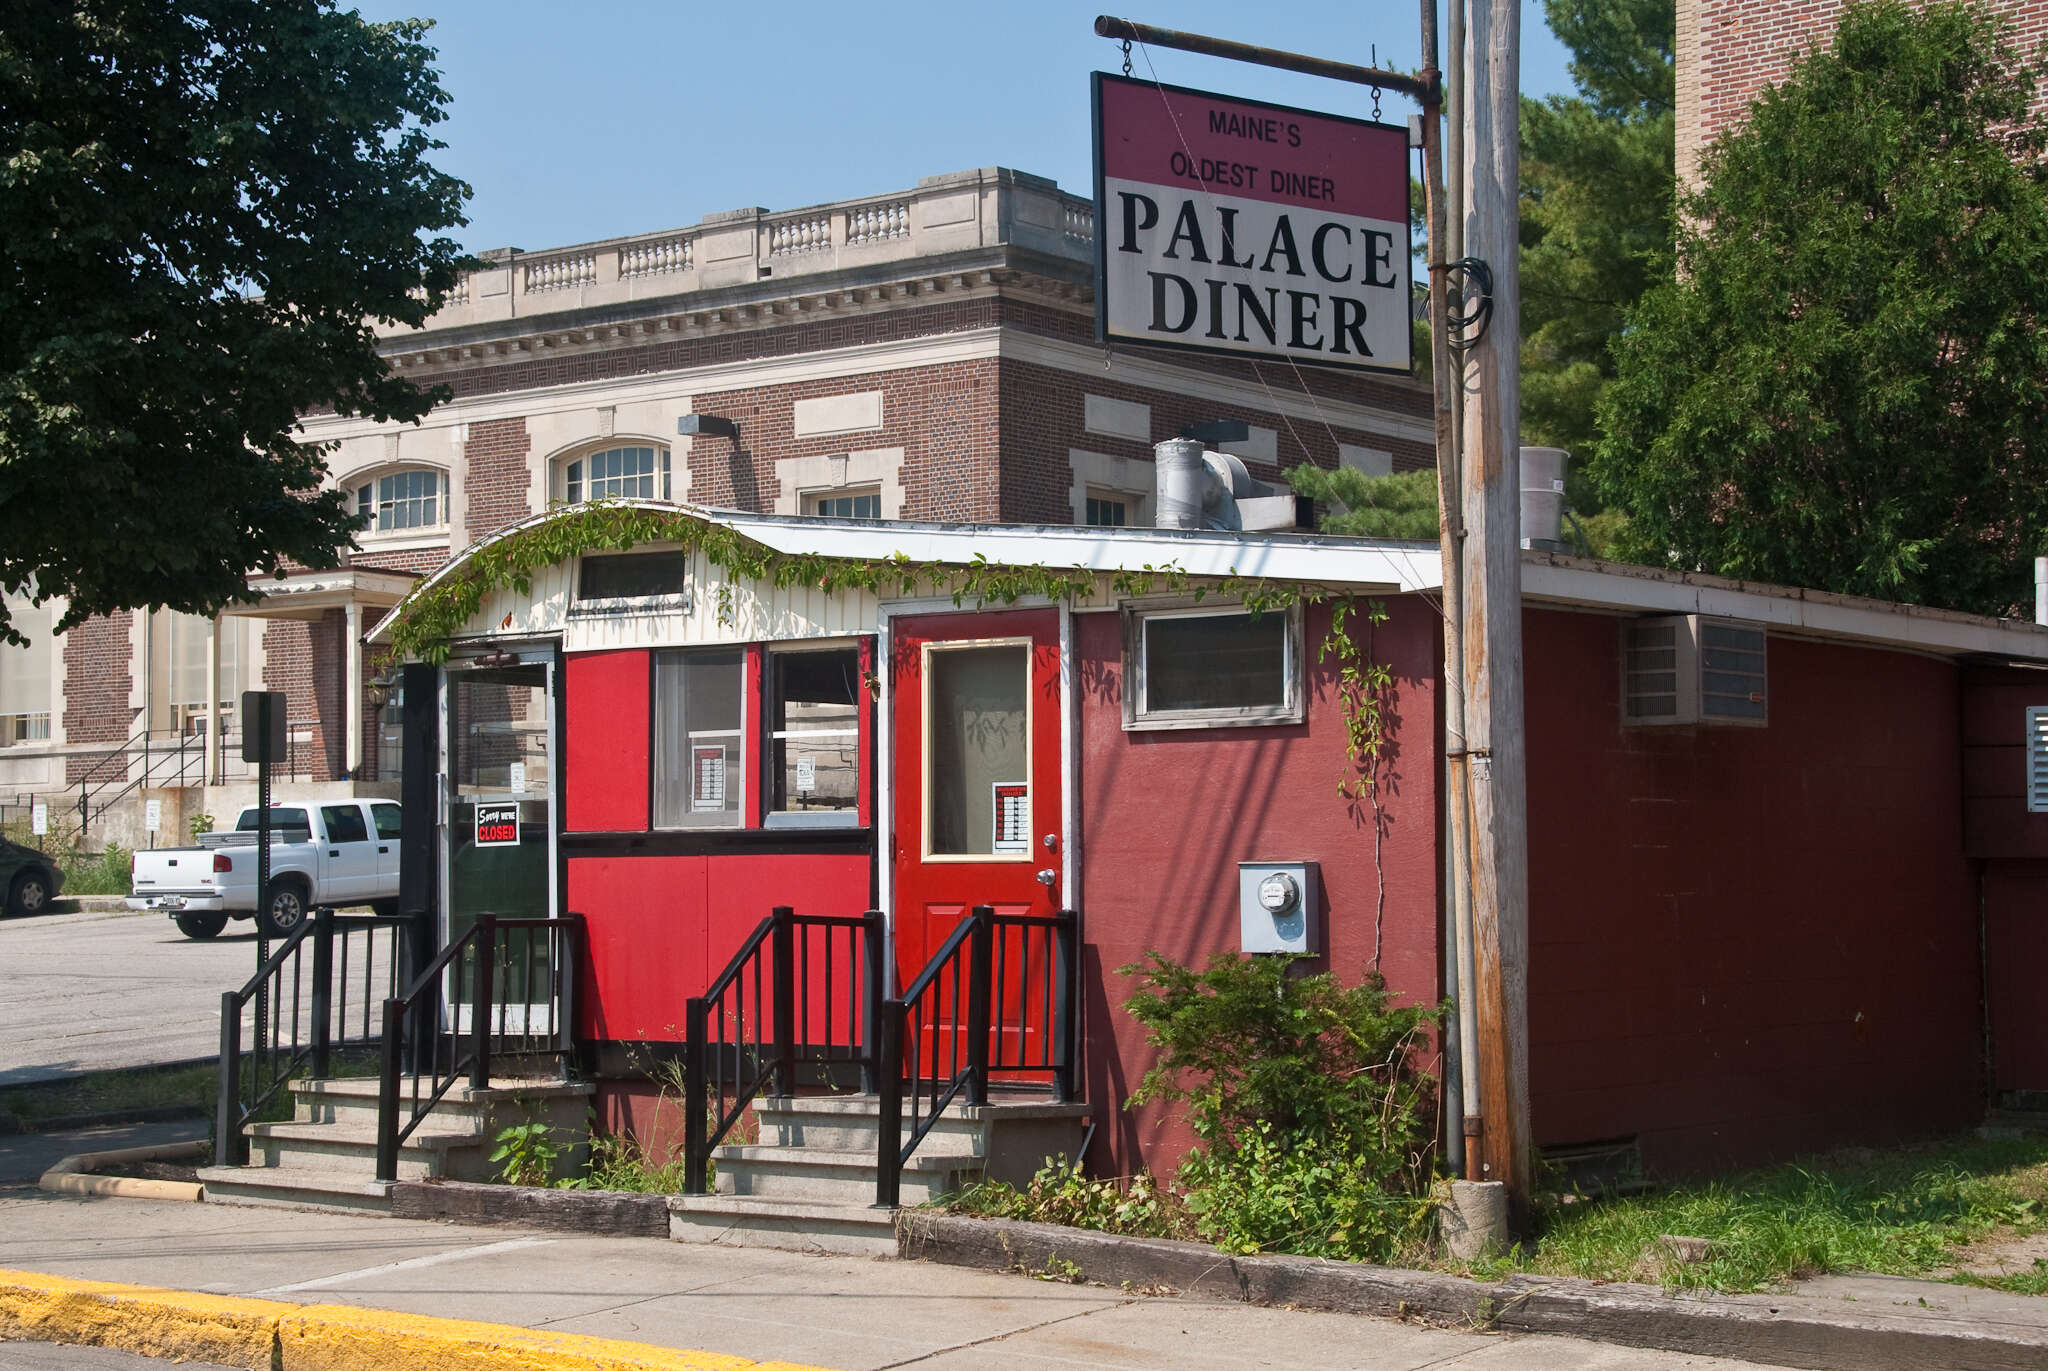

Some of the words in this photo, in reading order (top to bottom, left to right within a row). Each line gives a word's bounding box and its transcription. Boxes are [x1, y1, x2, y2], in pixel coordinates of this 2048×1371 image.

[1209, 110, 1301, 147] MAINE'S
[1170, 151, 1258, 189] OLDEST
[1270, 170, 1335, 202] DINER
[1117, 191, 1397, 289] PALACE
[1147, 270, 1374, 357] DINER
[478, 824, 515, 841] CLOSED
[479, 809, 499, 824] Sorry
